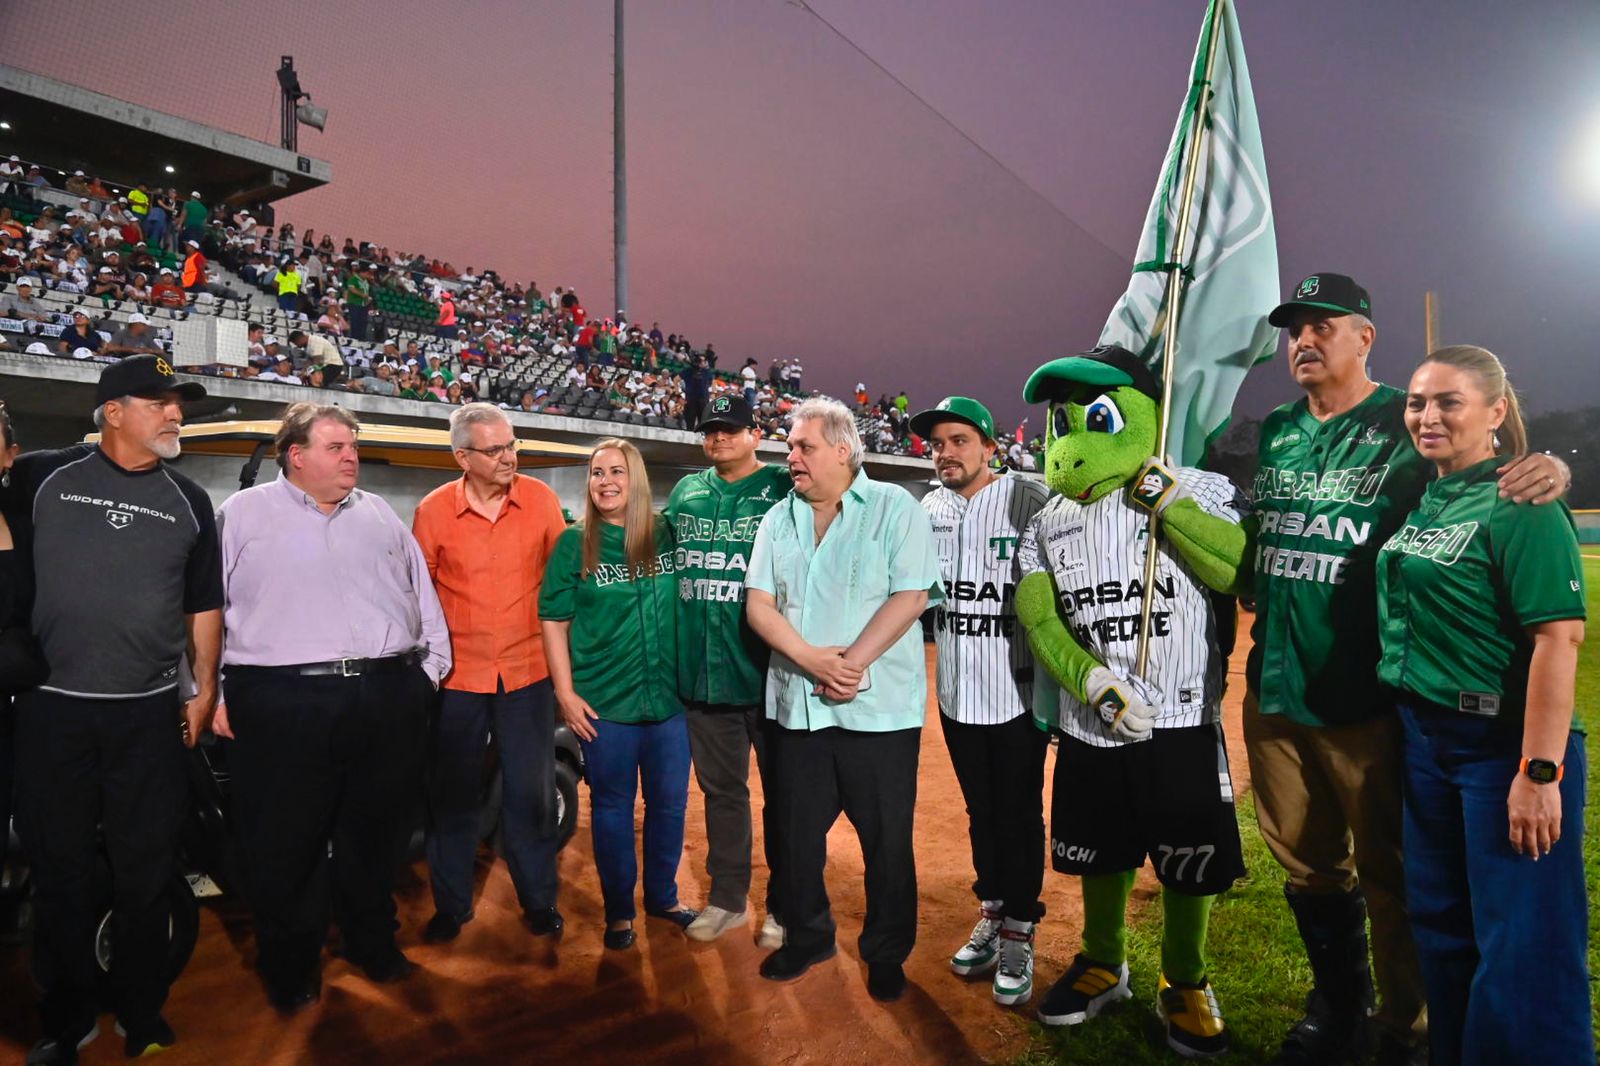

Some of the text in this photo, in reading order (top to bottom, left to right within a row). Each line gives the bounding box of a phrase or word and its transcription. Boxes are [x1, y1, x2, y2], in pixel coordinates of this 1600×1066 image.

[60, 493, 176, 523] UNDER ARMOUR
[1255, 509, 1372, 546] RSAN
[1262, 545, 1352, 584] TECATE
[1158, 844, 1215, 884] 777
